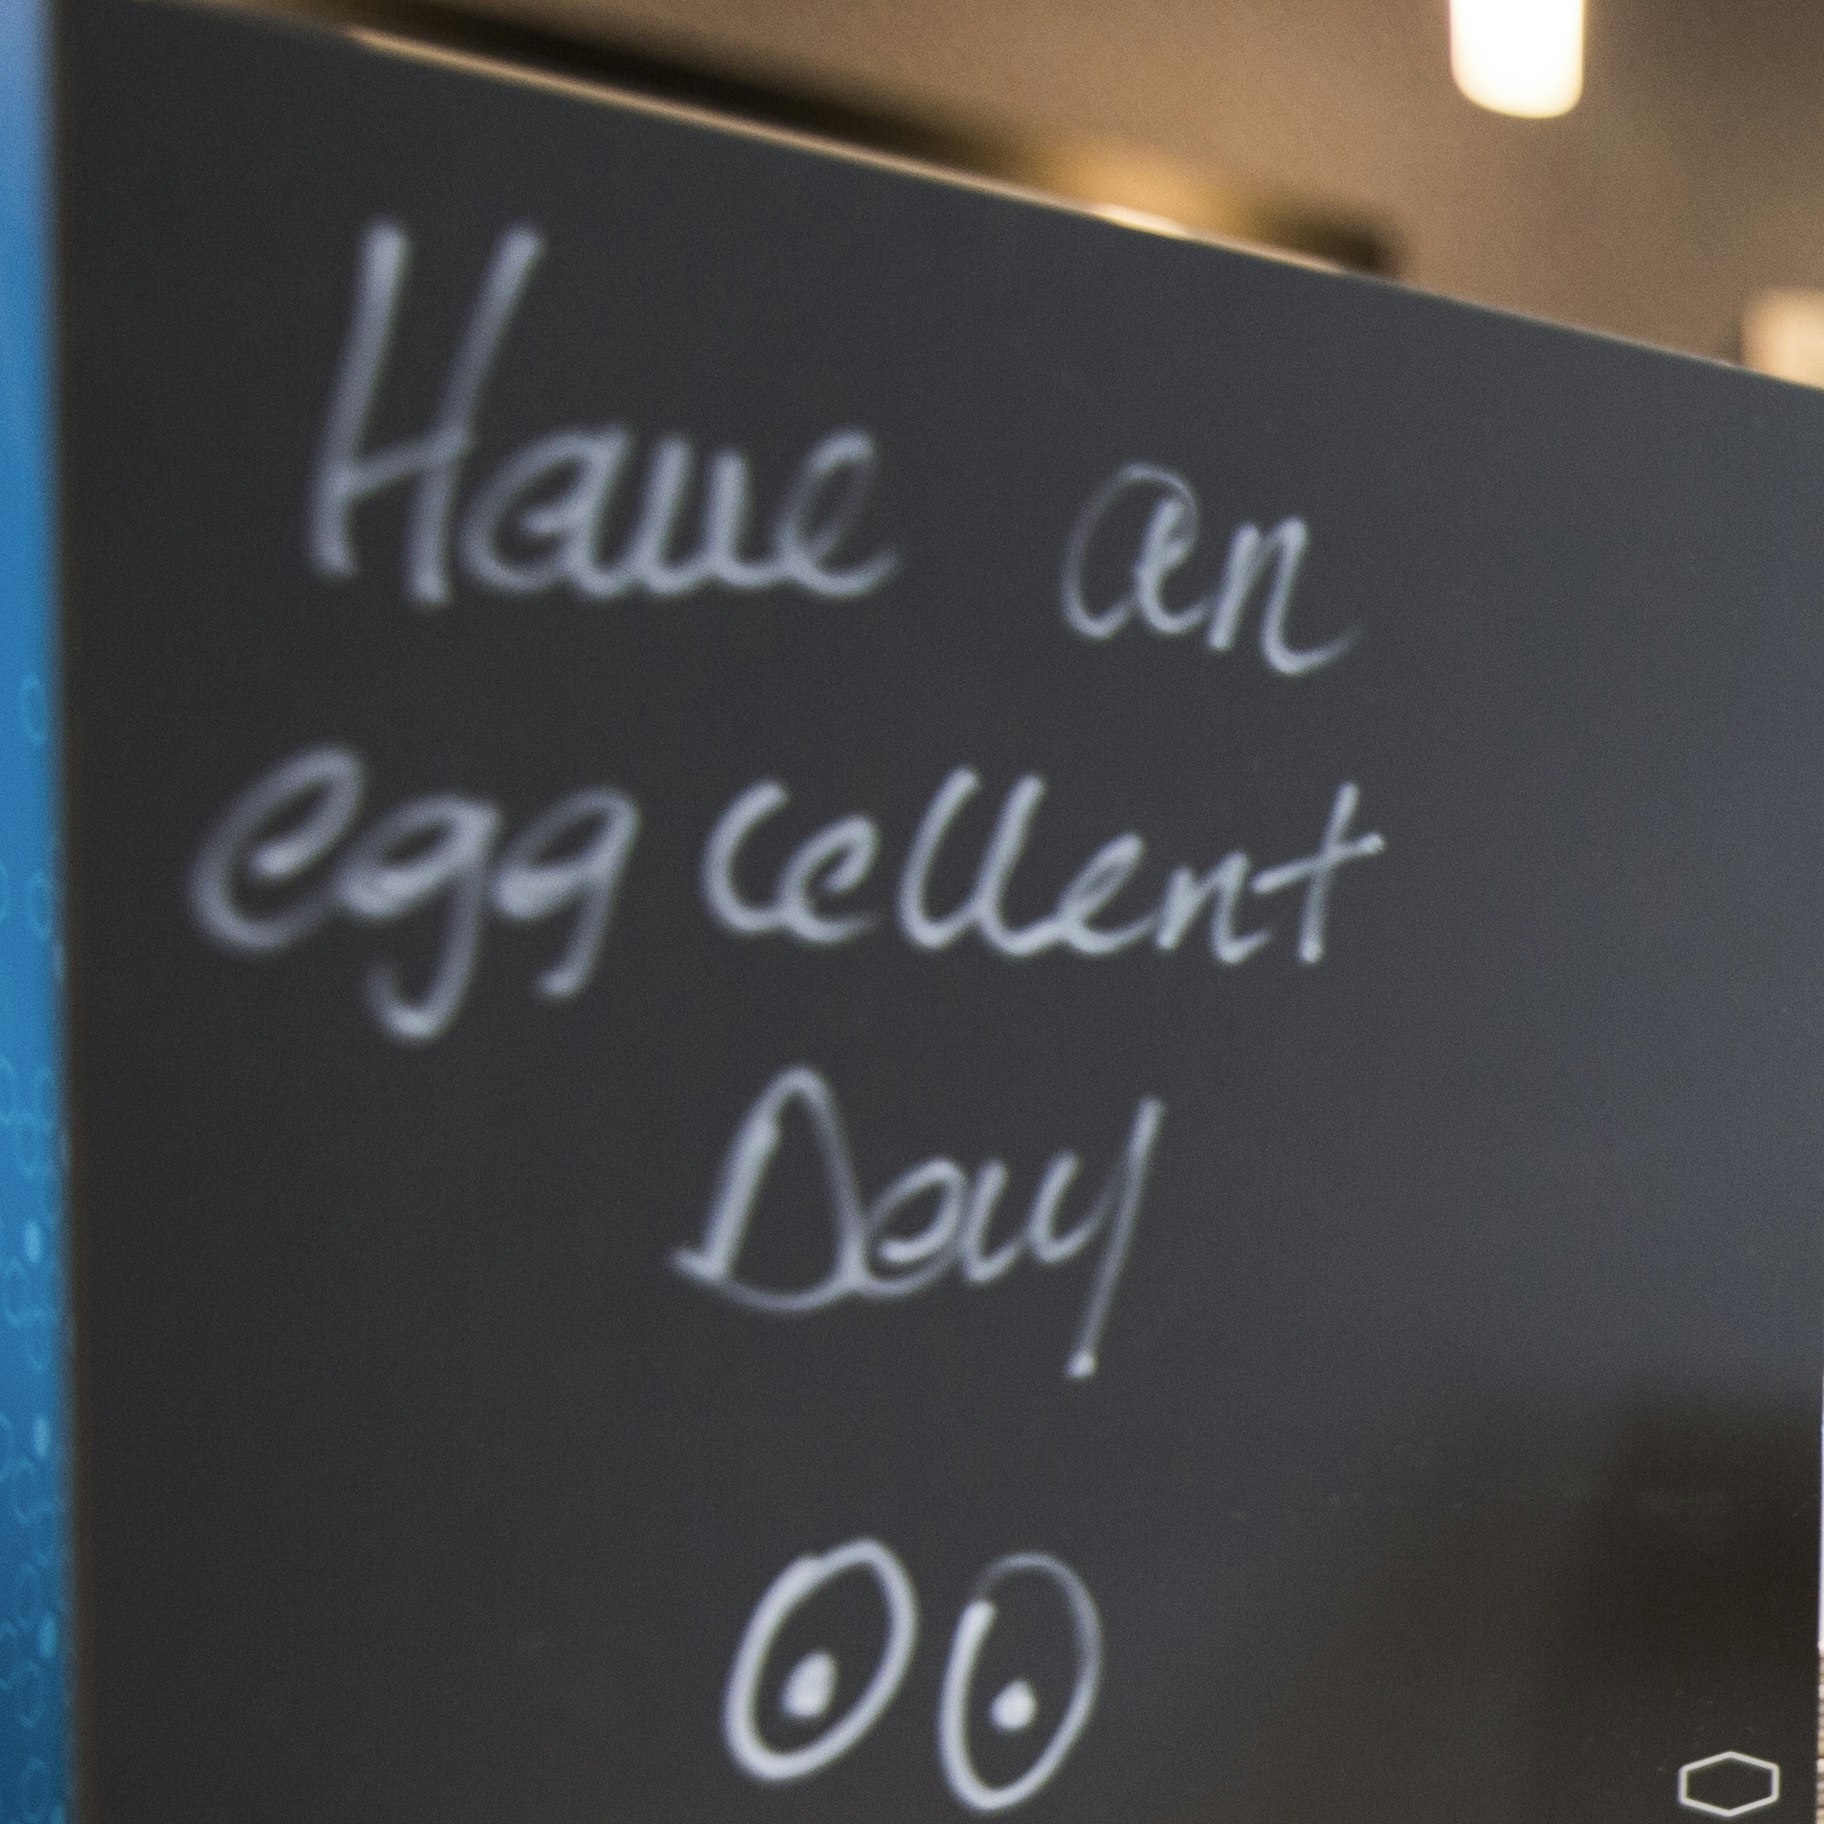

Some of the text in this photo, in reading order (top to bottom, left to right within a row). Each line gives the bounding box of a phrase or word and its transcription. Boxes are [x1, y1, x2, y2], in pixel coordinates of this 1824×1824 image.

[308, 222, 1356, 676] Have an
[671, 1066, 1166, 1380] Day
